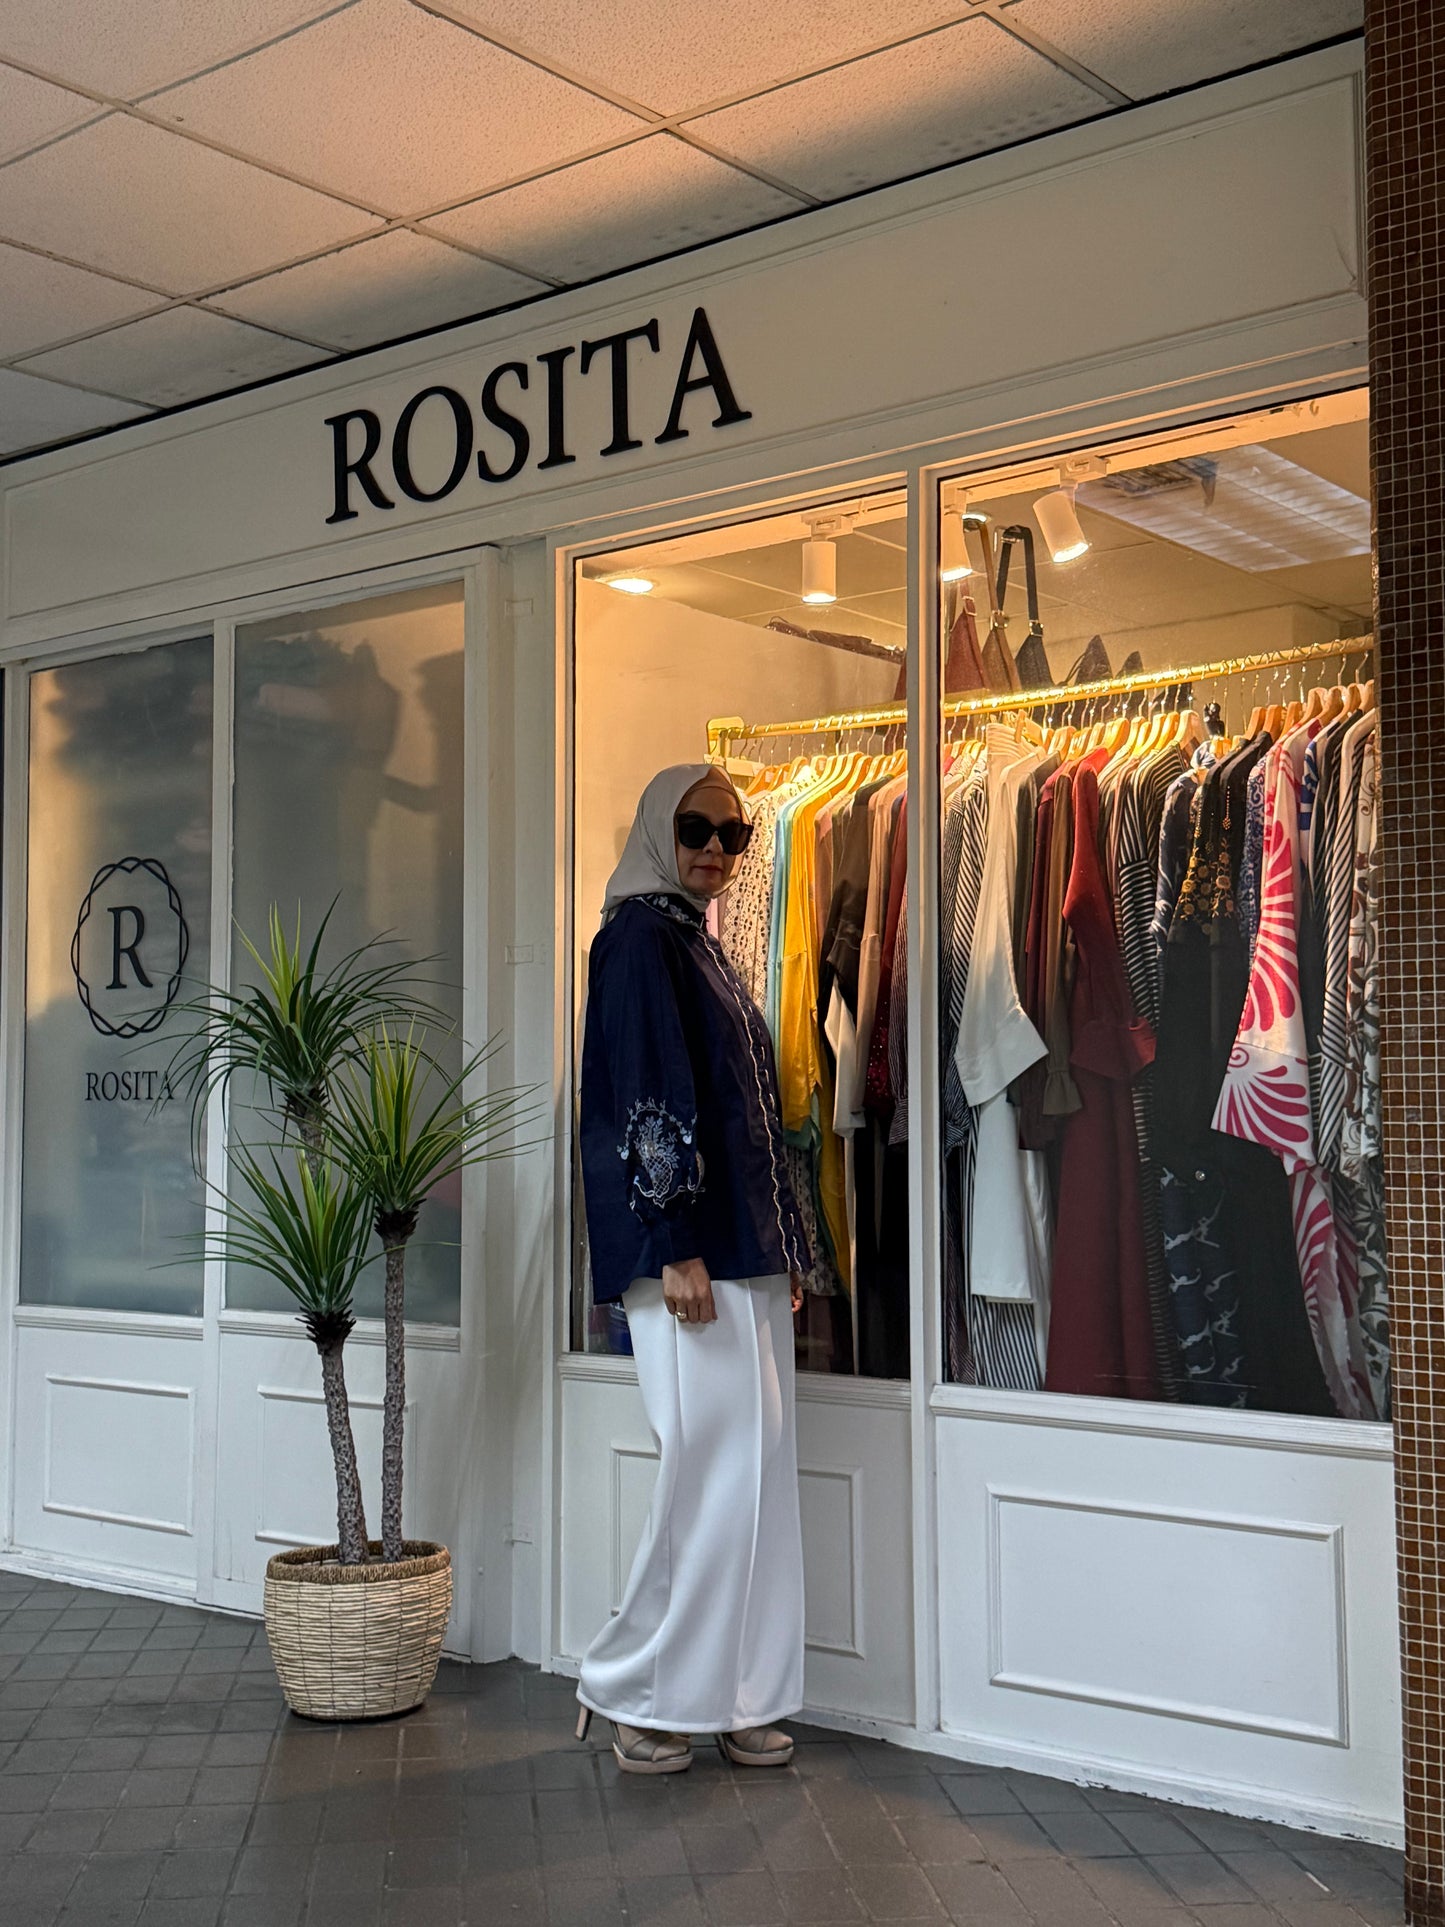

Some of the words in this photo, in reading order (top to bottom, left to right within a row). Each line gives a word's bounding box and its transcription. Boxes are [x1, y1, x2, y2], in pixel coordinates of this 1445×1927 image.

[324, 306, 752, 525] ROSITA
[106, 905, 153, 990] R
[85, 1070, 175, 1101] ROSITA
